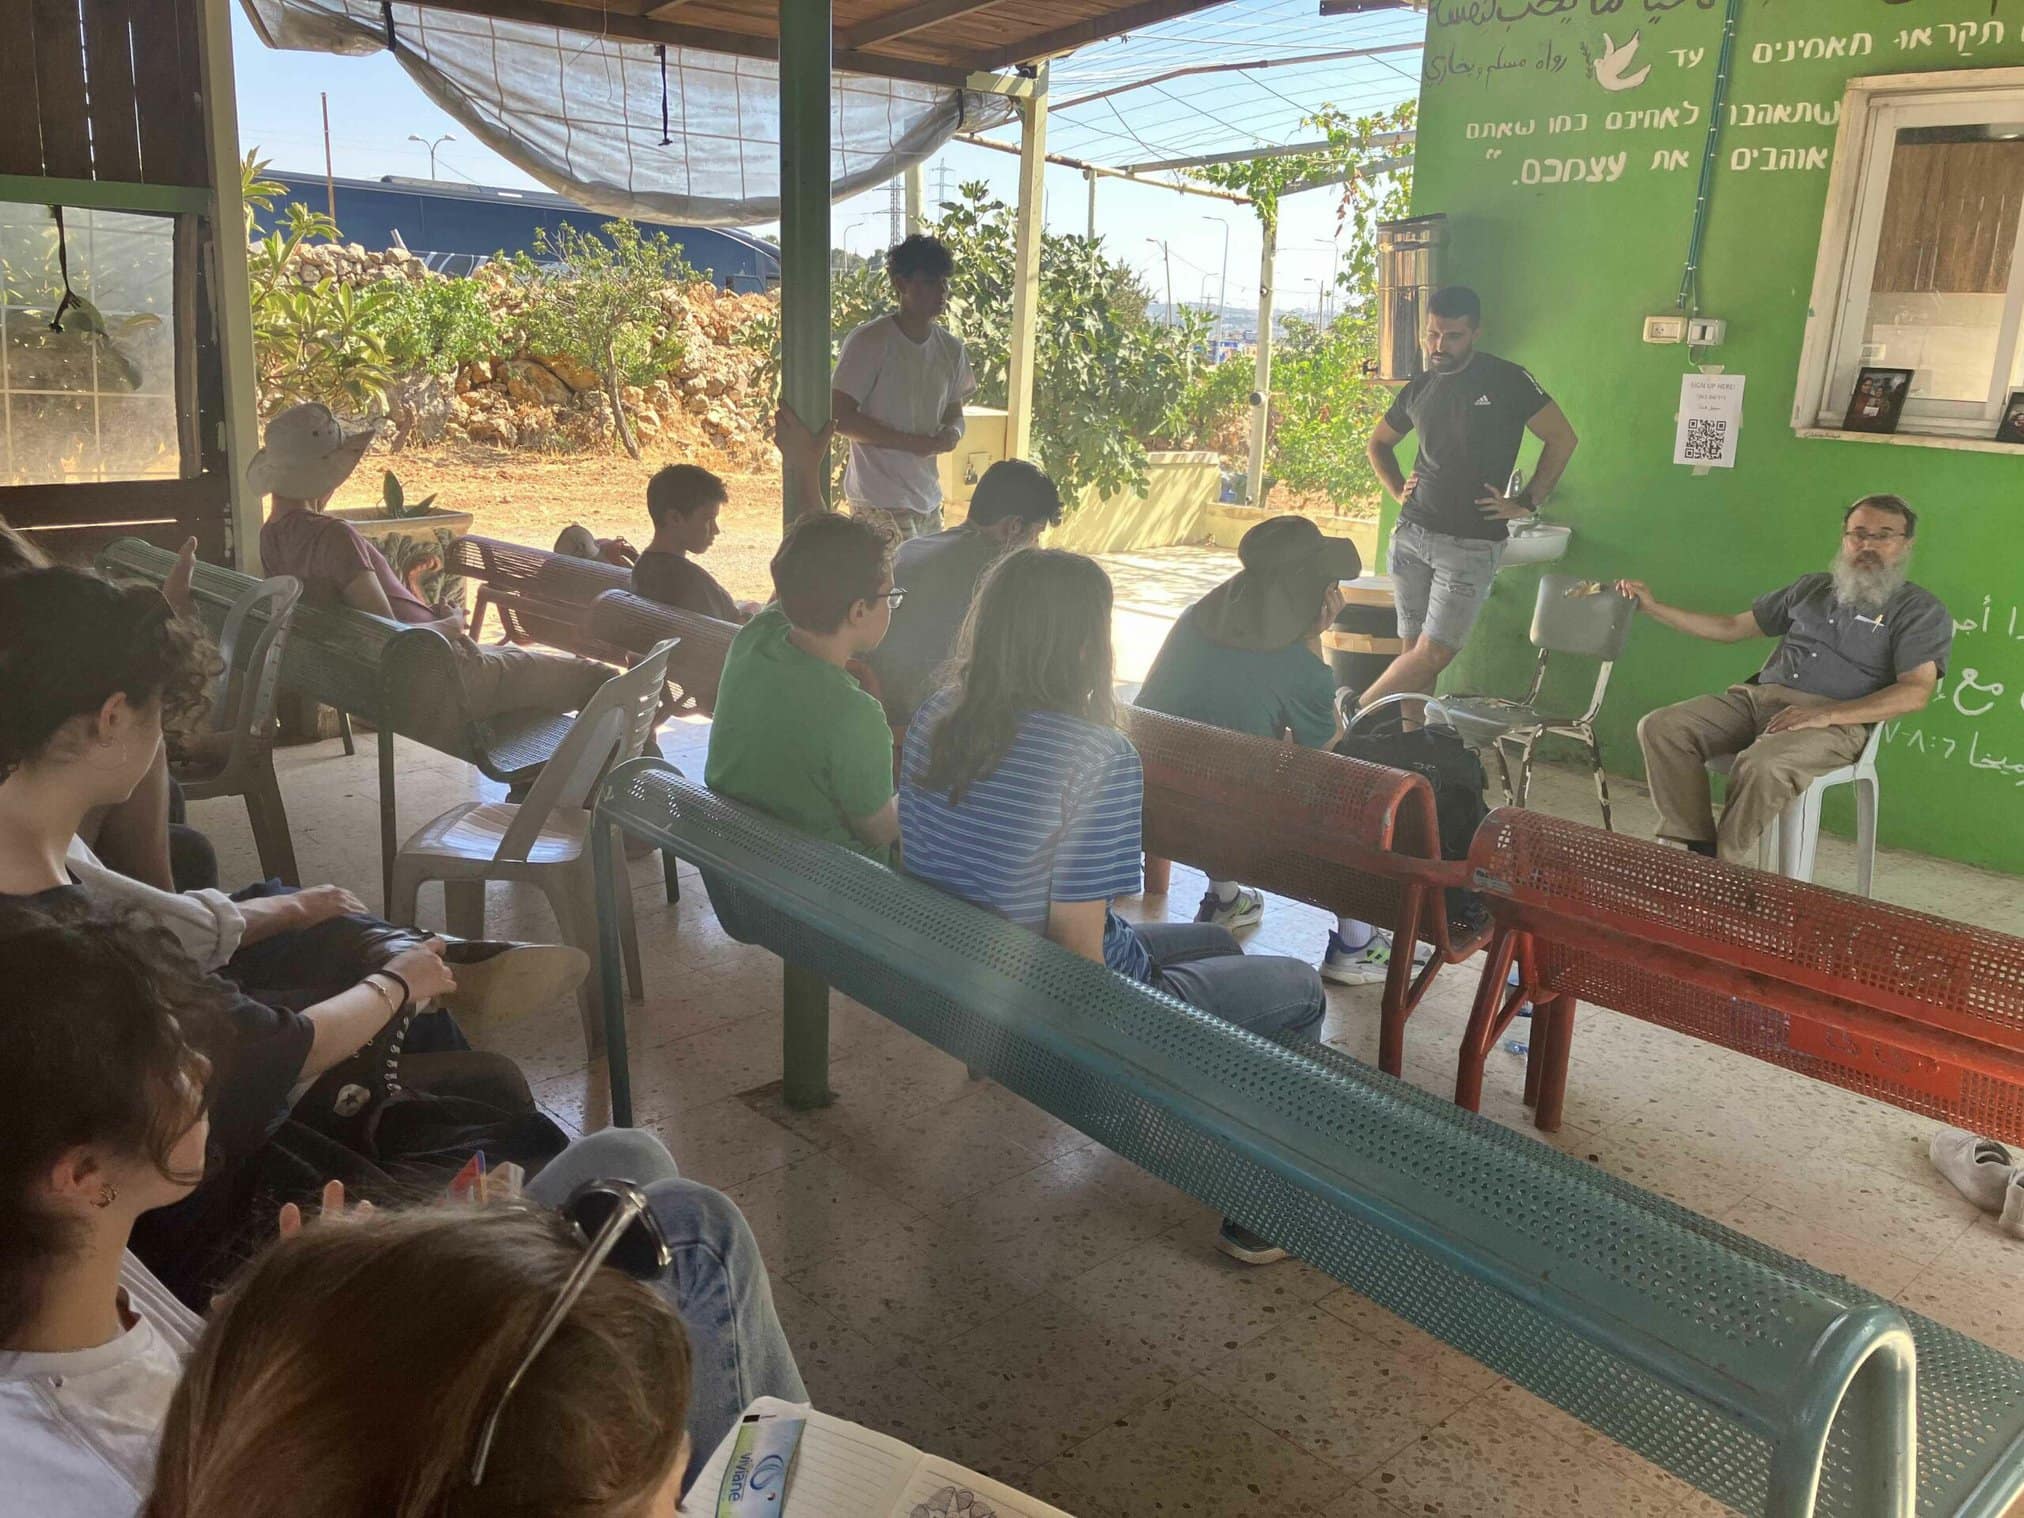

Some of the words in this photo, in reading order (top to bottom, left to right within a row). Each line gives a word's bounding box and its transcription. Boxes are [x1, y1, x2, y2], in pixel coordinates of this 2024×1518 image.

[1666, 47, 1705, 69] עד
[1751, 31, 1873, 64] מאמינים
[1484, 44, 1527, 89] مسلم
[1548, 113, 1588, 135] כמו
[1604, 100, 1700, 131] לאחיכם
[1729, 100, 1841, 126] שתאהבו
[1465, 119, 1536, 140] שאתם
[1650, 149, 1690, 172] את
[1730, 146, 1828, 171] אוהבים
